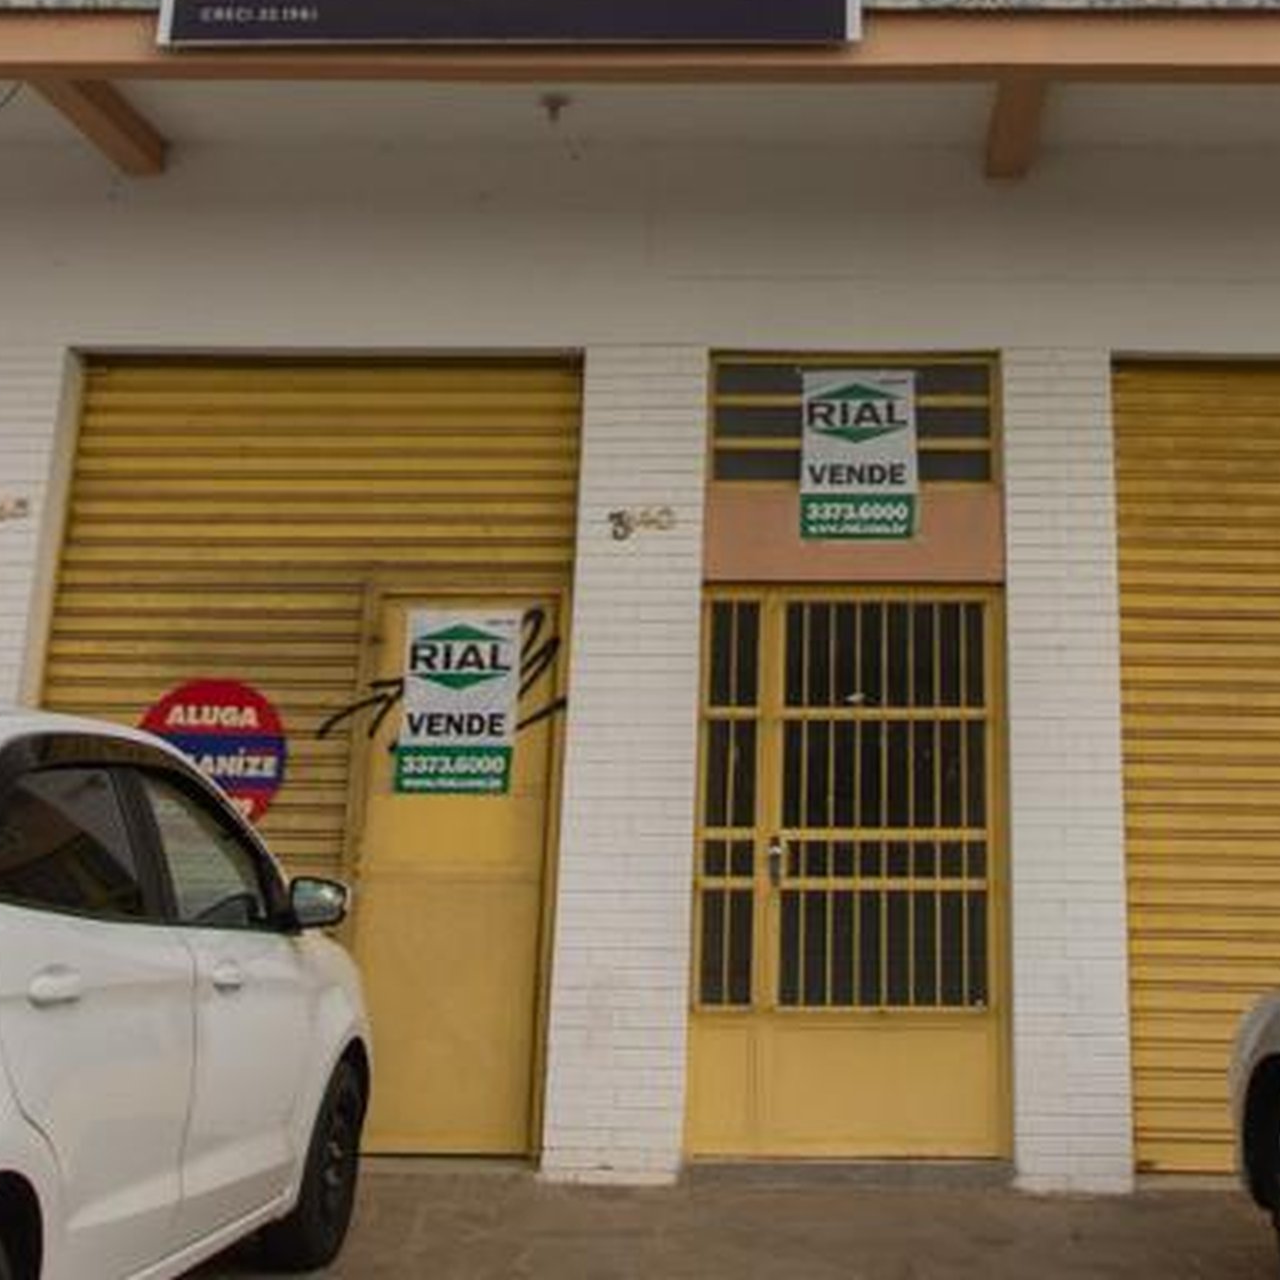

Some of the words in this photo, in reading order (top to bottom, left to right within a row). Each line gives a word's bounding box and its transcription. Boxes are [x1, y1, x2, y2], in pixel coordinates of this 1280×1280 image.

[807, 402, 908, 426] RIAL
[808, 464, 907, 485] VENDE
[409, 643, 511, 671] RIAL
[165, 704, 260, 728] ALUGA
[407, 713, 506, 736] VENDE
